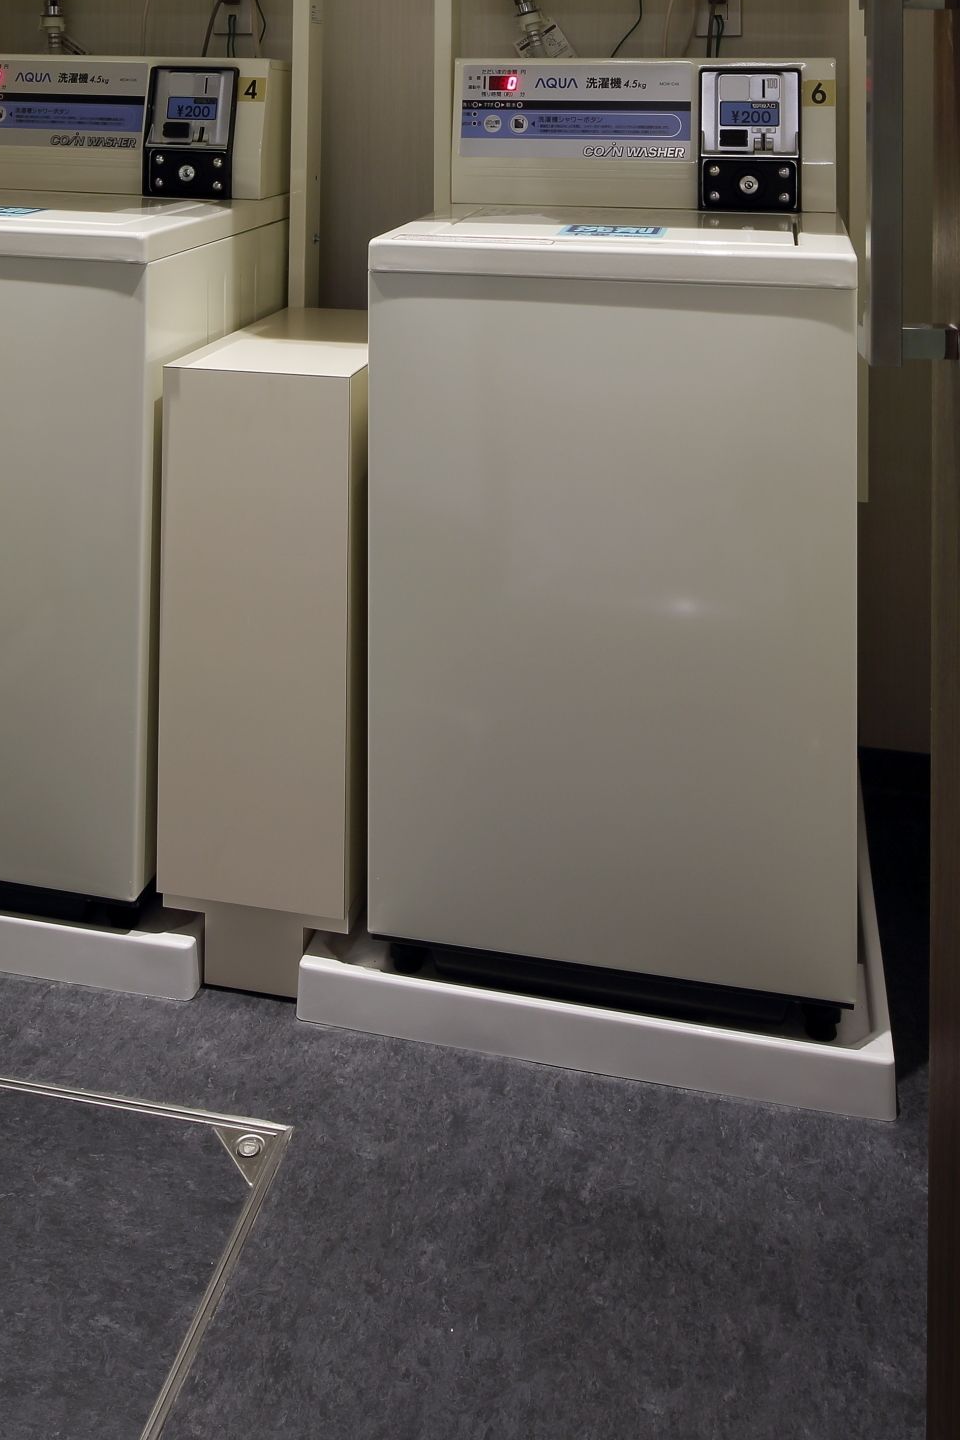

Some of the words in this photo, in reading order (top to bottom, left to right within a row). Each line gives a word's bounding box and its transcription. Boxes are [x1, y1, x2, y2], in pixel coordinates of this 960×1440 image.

[15, 71, 51, 83] AQUA
[58, 72, 88, 84] 洗濯機
[90, 75, 110, 85] 4.5kg
[506, 76, 517, 90] 0
[535, 77, 578, 89] AQUA
[585, 76, 622, 89] 洗濯機
[623, 79, 647, 90] 4.5kg
[243, 79, 257, 99] 4
[811, 82, 827, 105] 6
[177, 105, 211, 118] ¥200
[731, 110, 771, 124] ¥200
[50, 131, 85, 147] COIN
[87, 136, 136, 148] WASHER
[583, 141, 623, 158] COIN
[627, 146, 685, 158] WASHER
